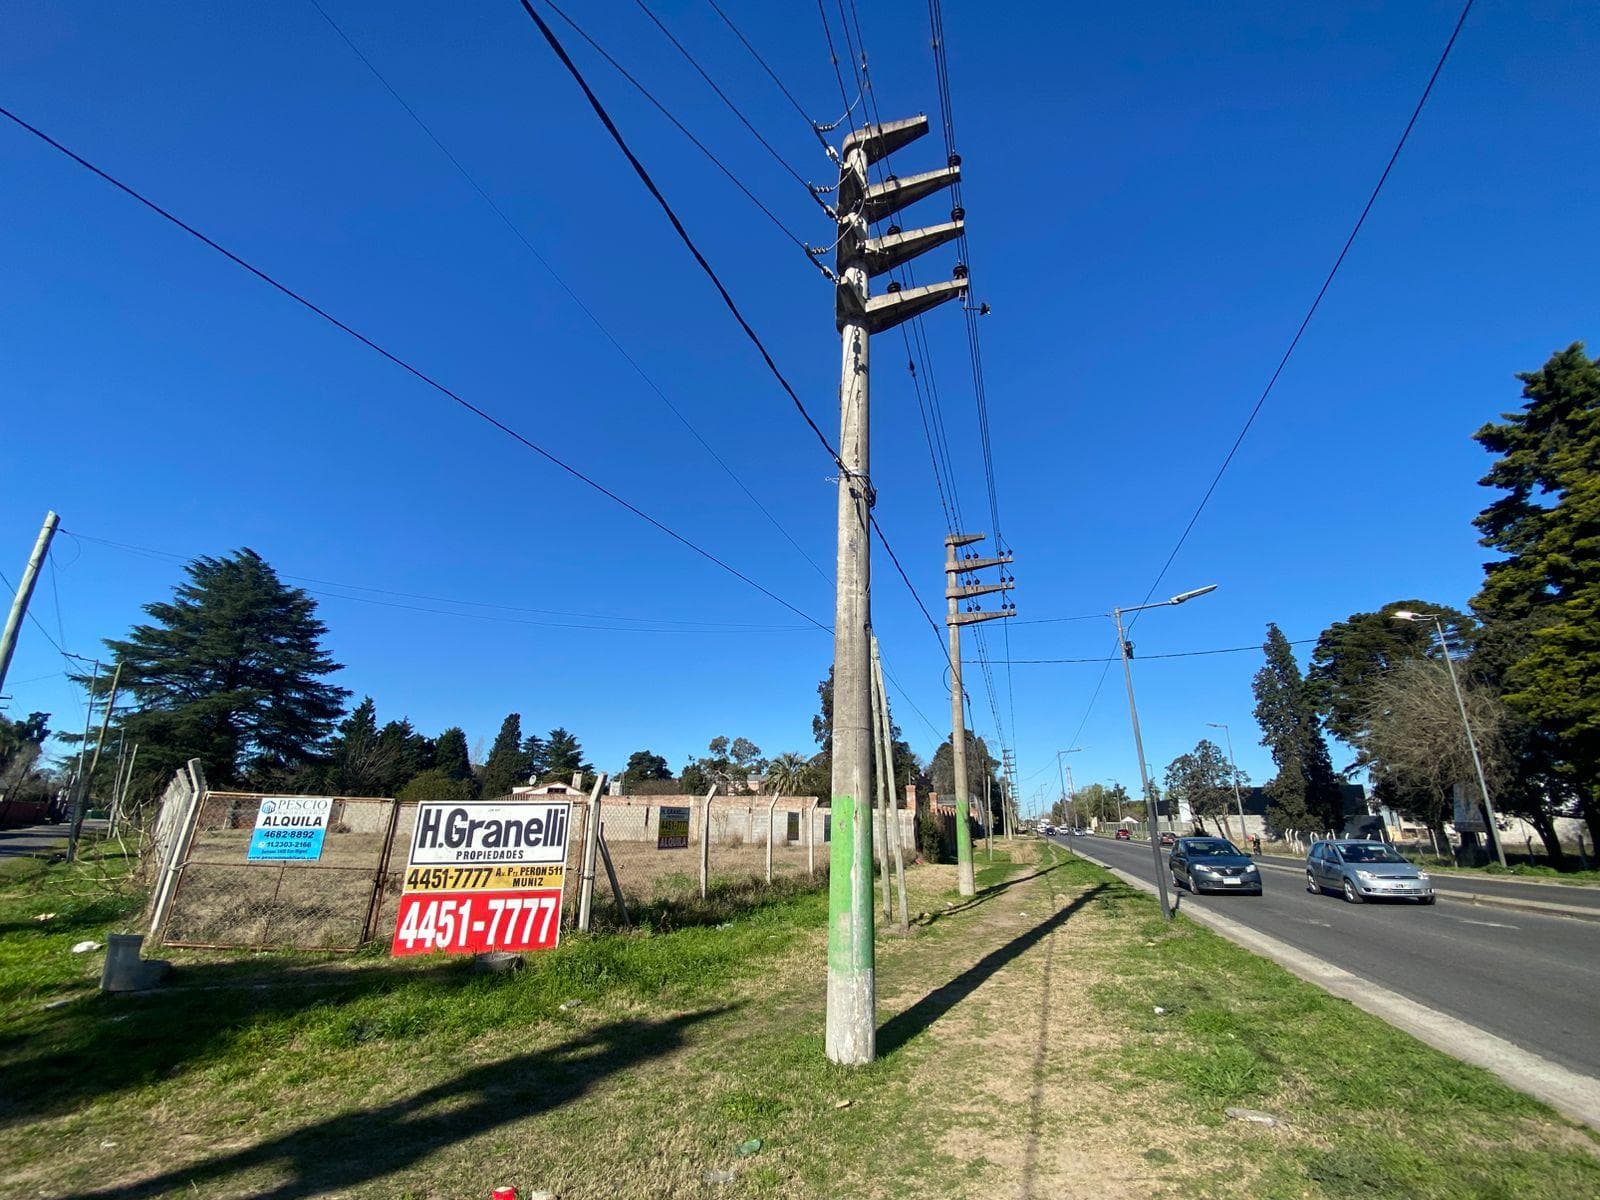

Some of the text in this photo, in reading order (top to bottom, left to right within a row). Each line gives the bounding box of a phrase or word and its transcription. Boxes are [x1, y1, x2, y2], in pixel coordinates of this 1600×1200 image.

[278, 799, 328, 810] PESCIO
[262, 816, 322, 827] ALQUILA
[418, 807, 566, 849] H.Granelli
[455, 849, 524, 860] PROPIEDADES
[519, 866, 547, 876] PERON
[548, 866, 563, 875] 511
[407, 867, 493, 889] 4451-7777
[398, 896, 557, 949] 4451-7777
